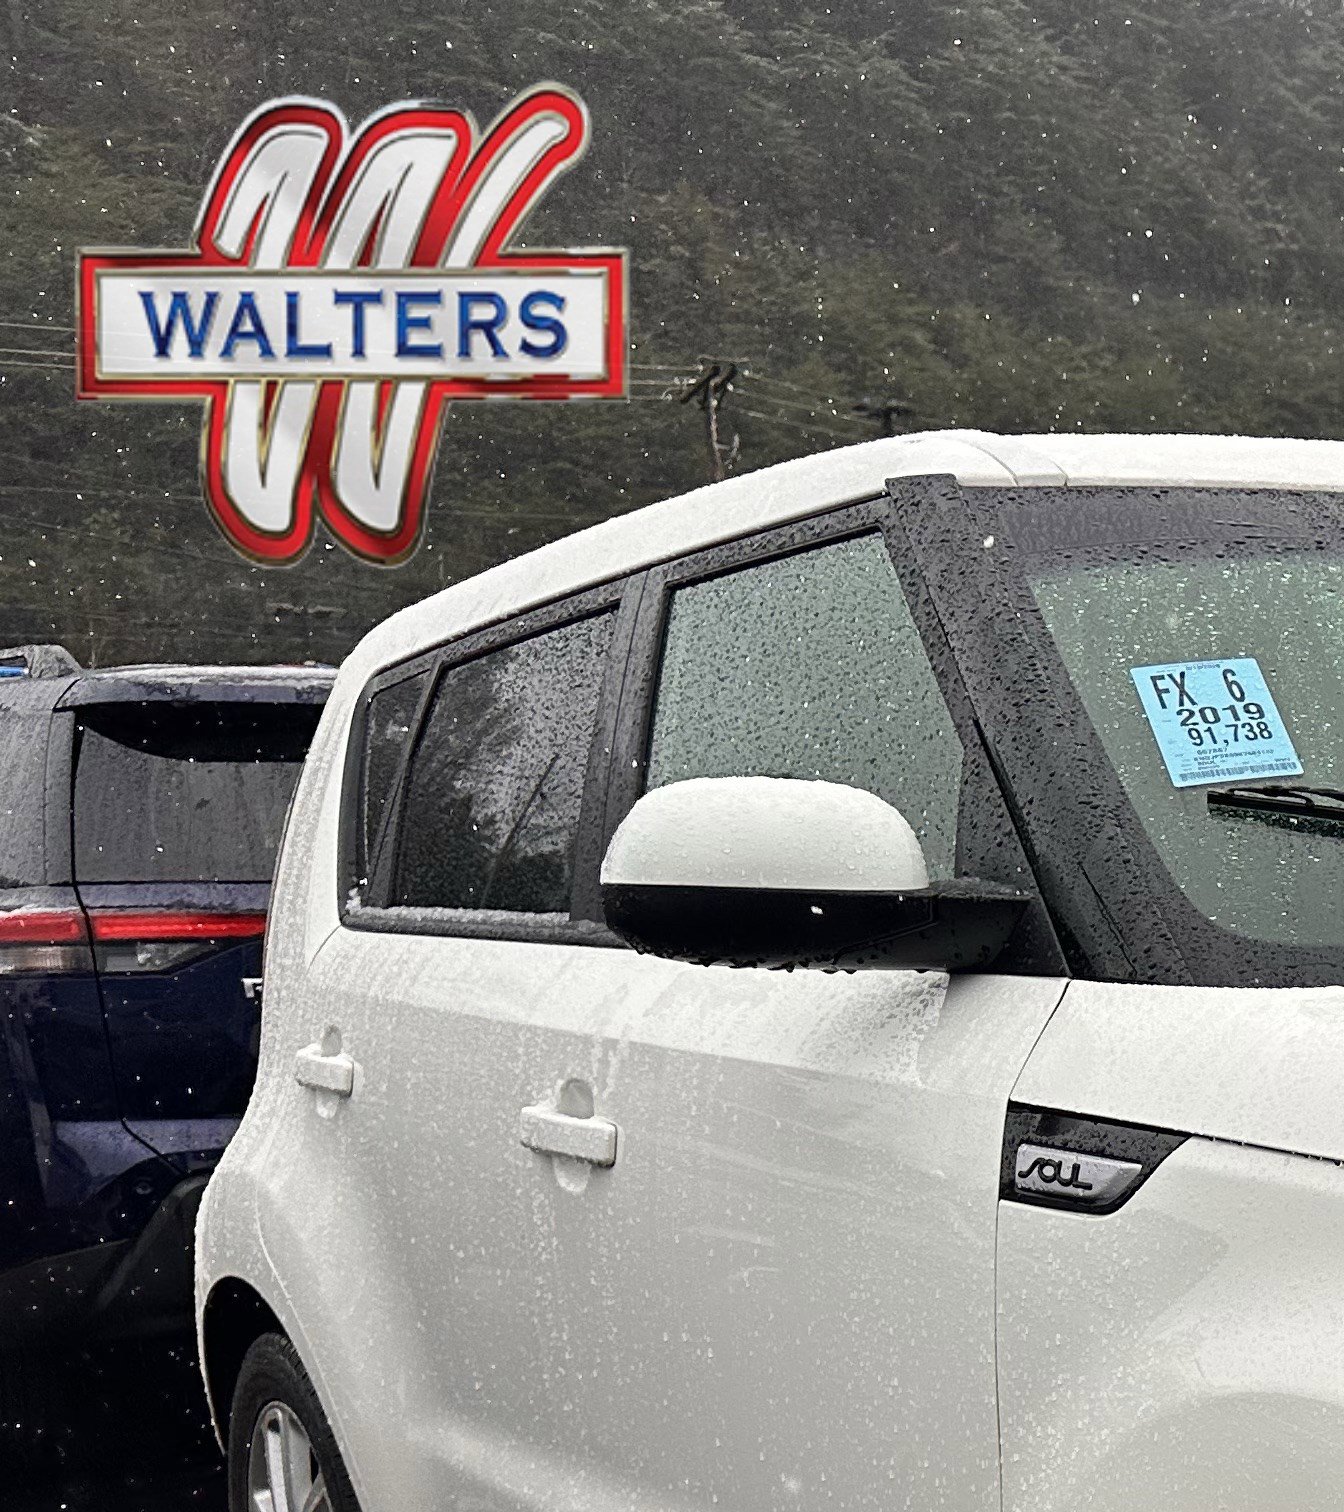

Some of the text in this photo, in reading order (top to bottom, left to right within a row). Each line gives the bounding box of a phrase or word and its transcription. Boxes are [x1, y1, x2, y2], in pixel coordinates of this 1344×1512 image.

[1149, 668, 1246, 710] FX 6
[1176, 702, 1266, 727] 2019
[1187, 721, 1273, 747] 91,738
[1018, 1156, 1093, 1191] SOUL
